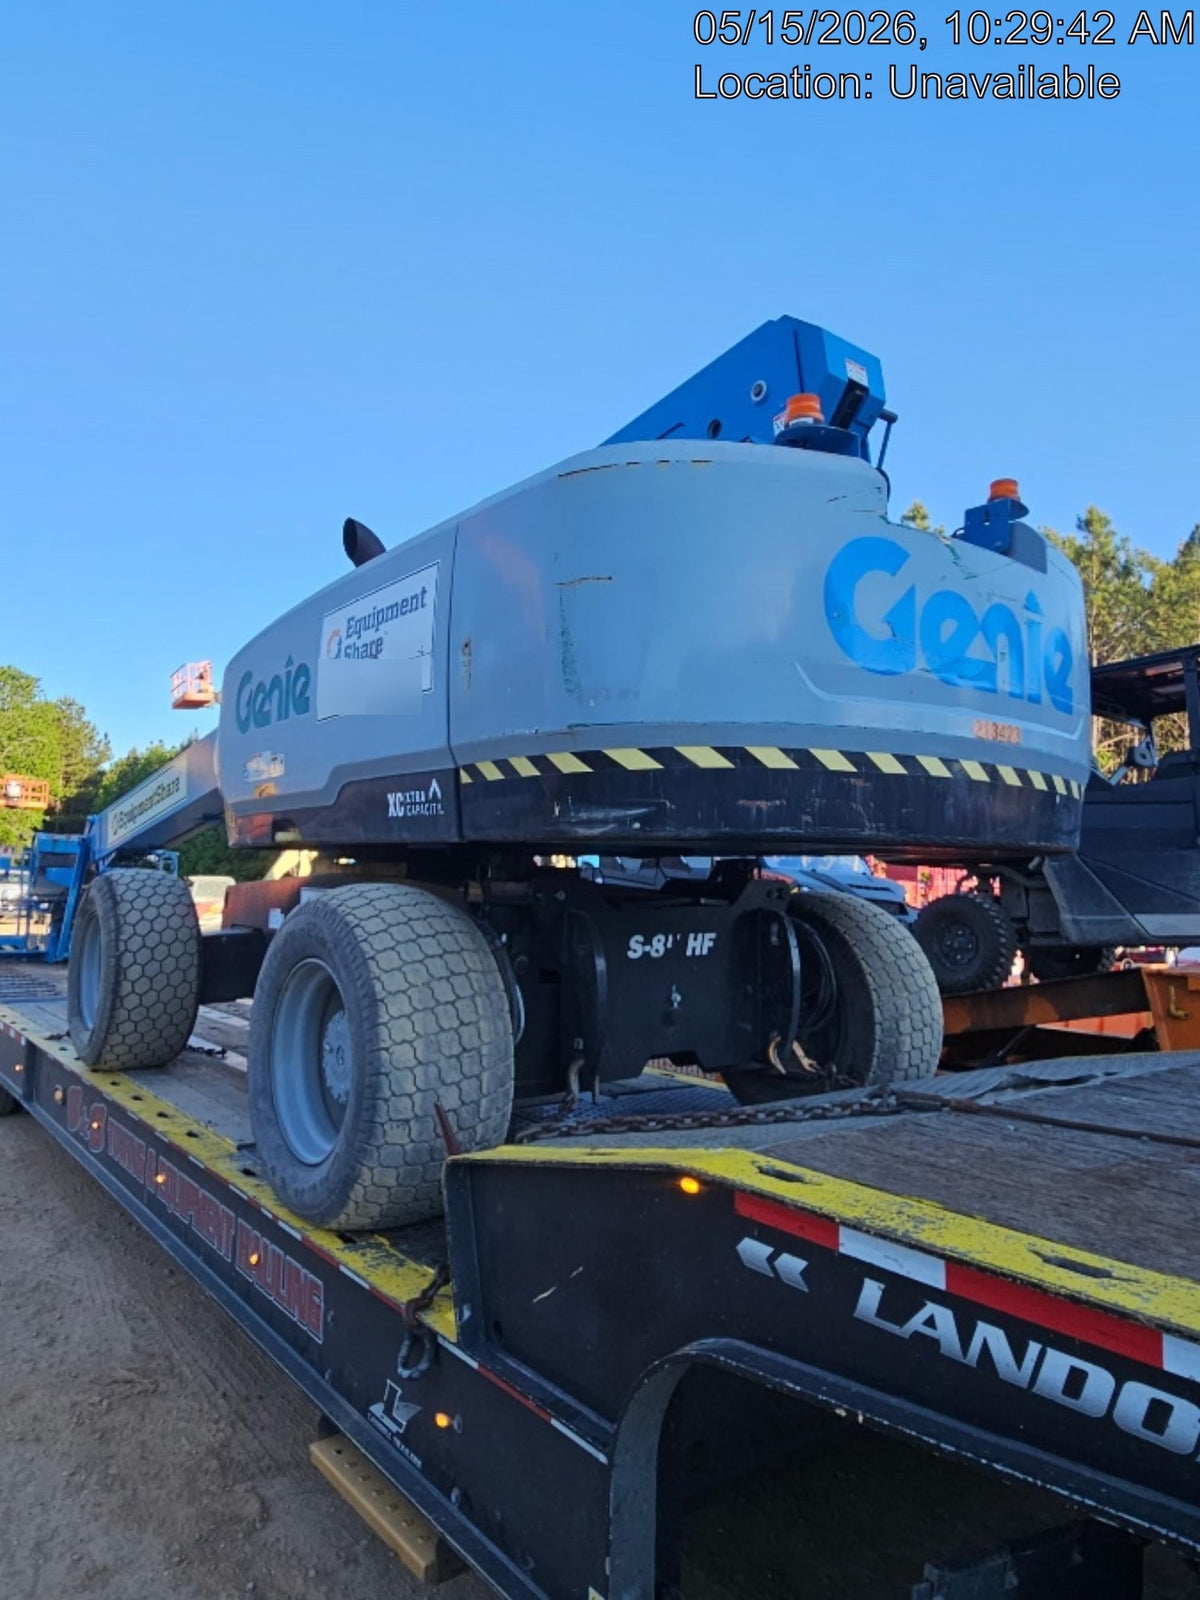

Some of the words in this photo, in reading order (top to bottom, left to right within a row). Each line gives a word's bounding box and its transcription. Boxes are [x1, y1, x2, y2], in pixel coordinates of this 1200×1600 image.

[344, 585, 428, 640] Equipment
[823, 536, 1074, 716] Genie
[235, 652, 311, 735] Genie
[386, 791, 405, 818] XC
[686, 932, 717, 957] HF
[852, 1277, 1200, 1463] LANDO
